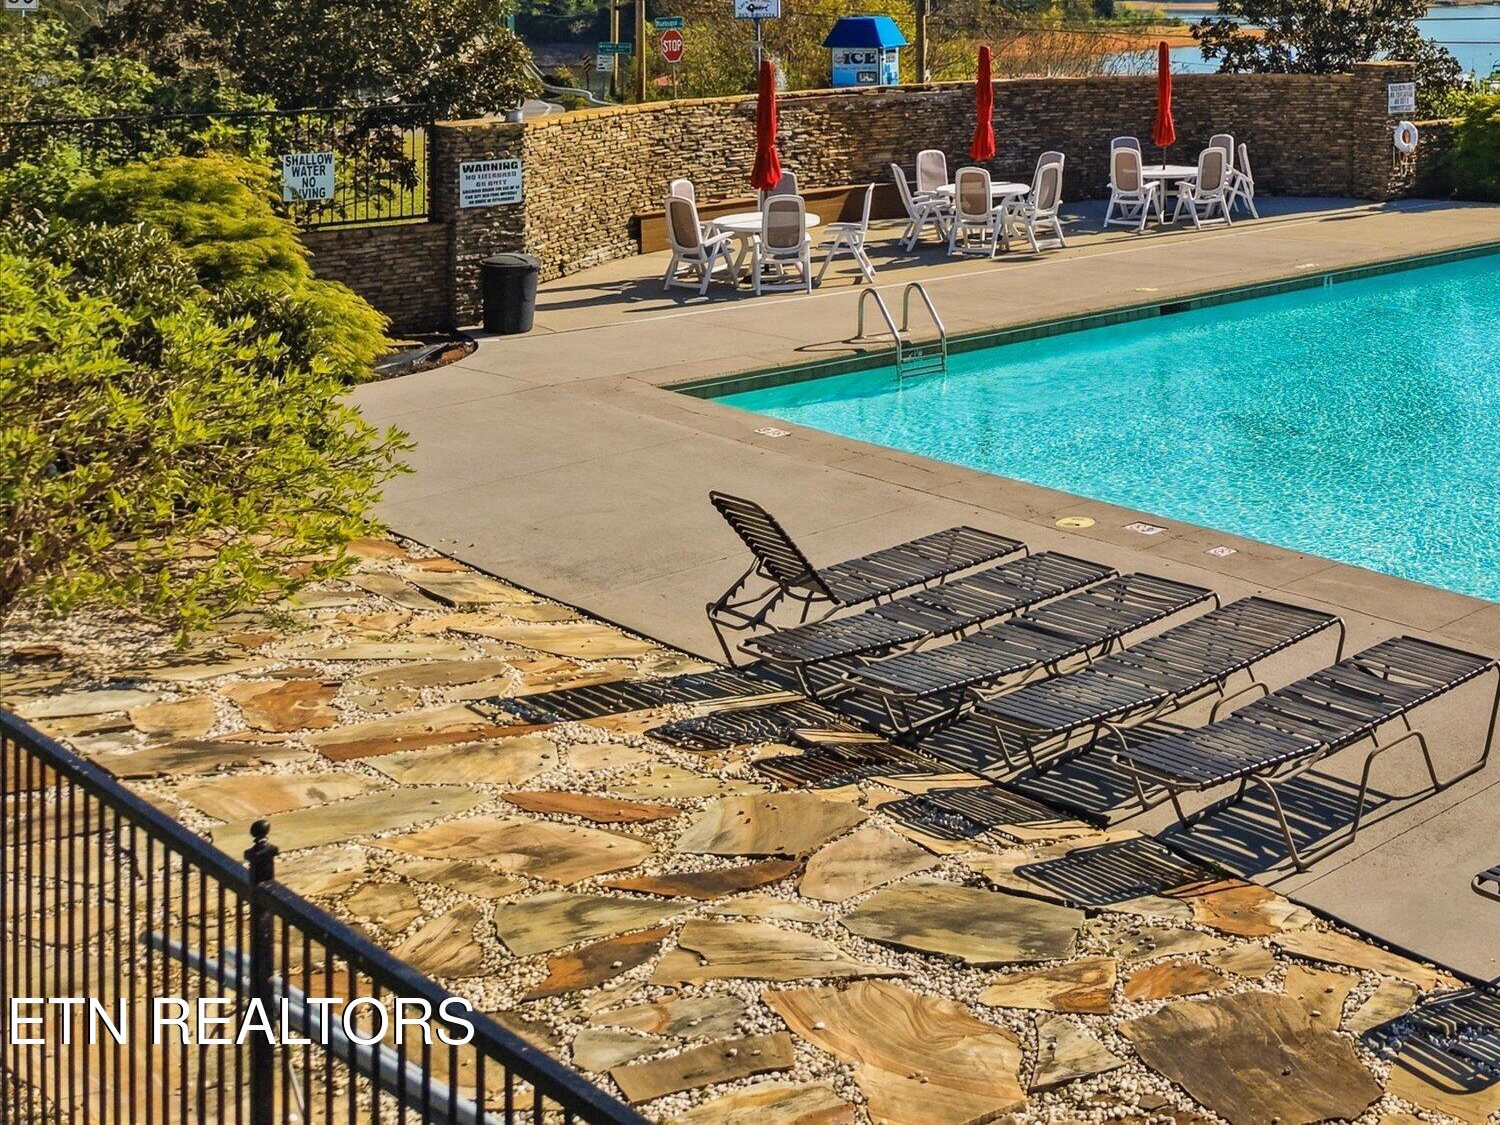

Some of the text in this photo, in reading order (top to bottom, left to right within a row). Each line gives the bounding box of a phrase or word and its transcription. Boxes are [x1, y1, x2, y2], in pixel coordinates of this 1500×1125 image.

[663, 39, 682, 53] STOP
[843, 52, 877, 65] ICE
[285, 153, 333, 167] SHALLOW
[292, 165, 326, 178] WATER
[462, 161, 519, 174] WARNING
[302, 176, 316, 188] NO
